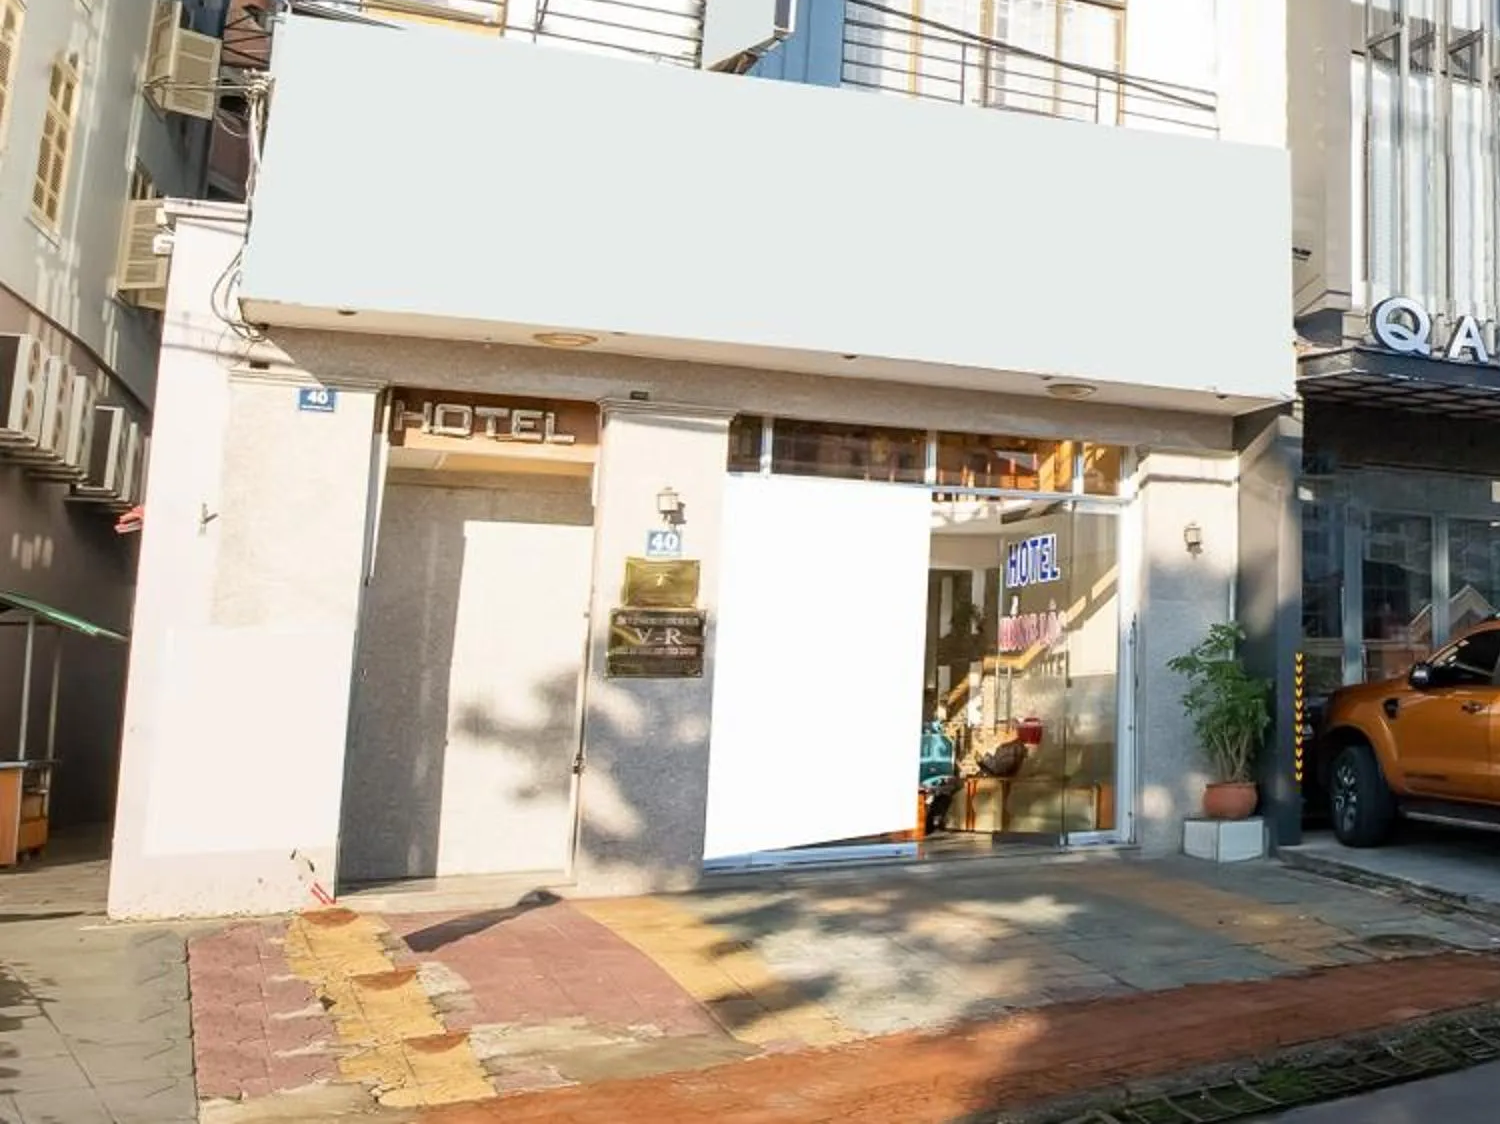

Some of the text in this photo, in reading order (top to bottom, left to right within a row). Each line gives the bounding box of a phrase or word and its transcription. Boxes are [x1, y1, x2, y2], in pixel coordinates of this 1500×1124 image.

[1370, 296, 1490, 364] QA
[307, 390, 329, 405] 40
[394, 398, 576, 446] HOTEL
[651, 532, 680, 551] 40
[1005, 534, 1060, 588] HOTEL
